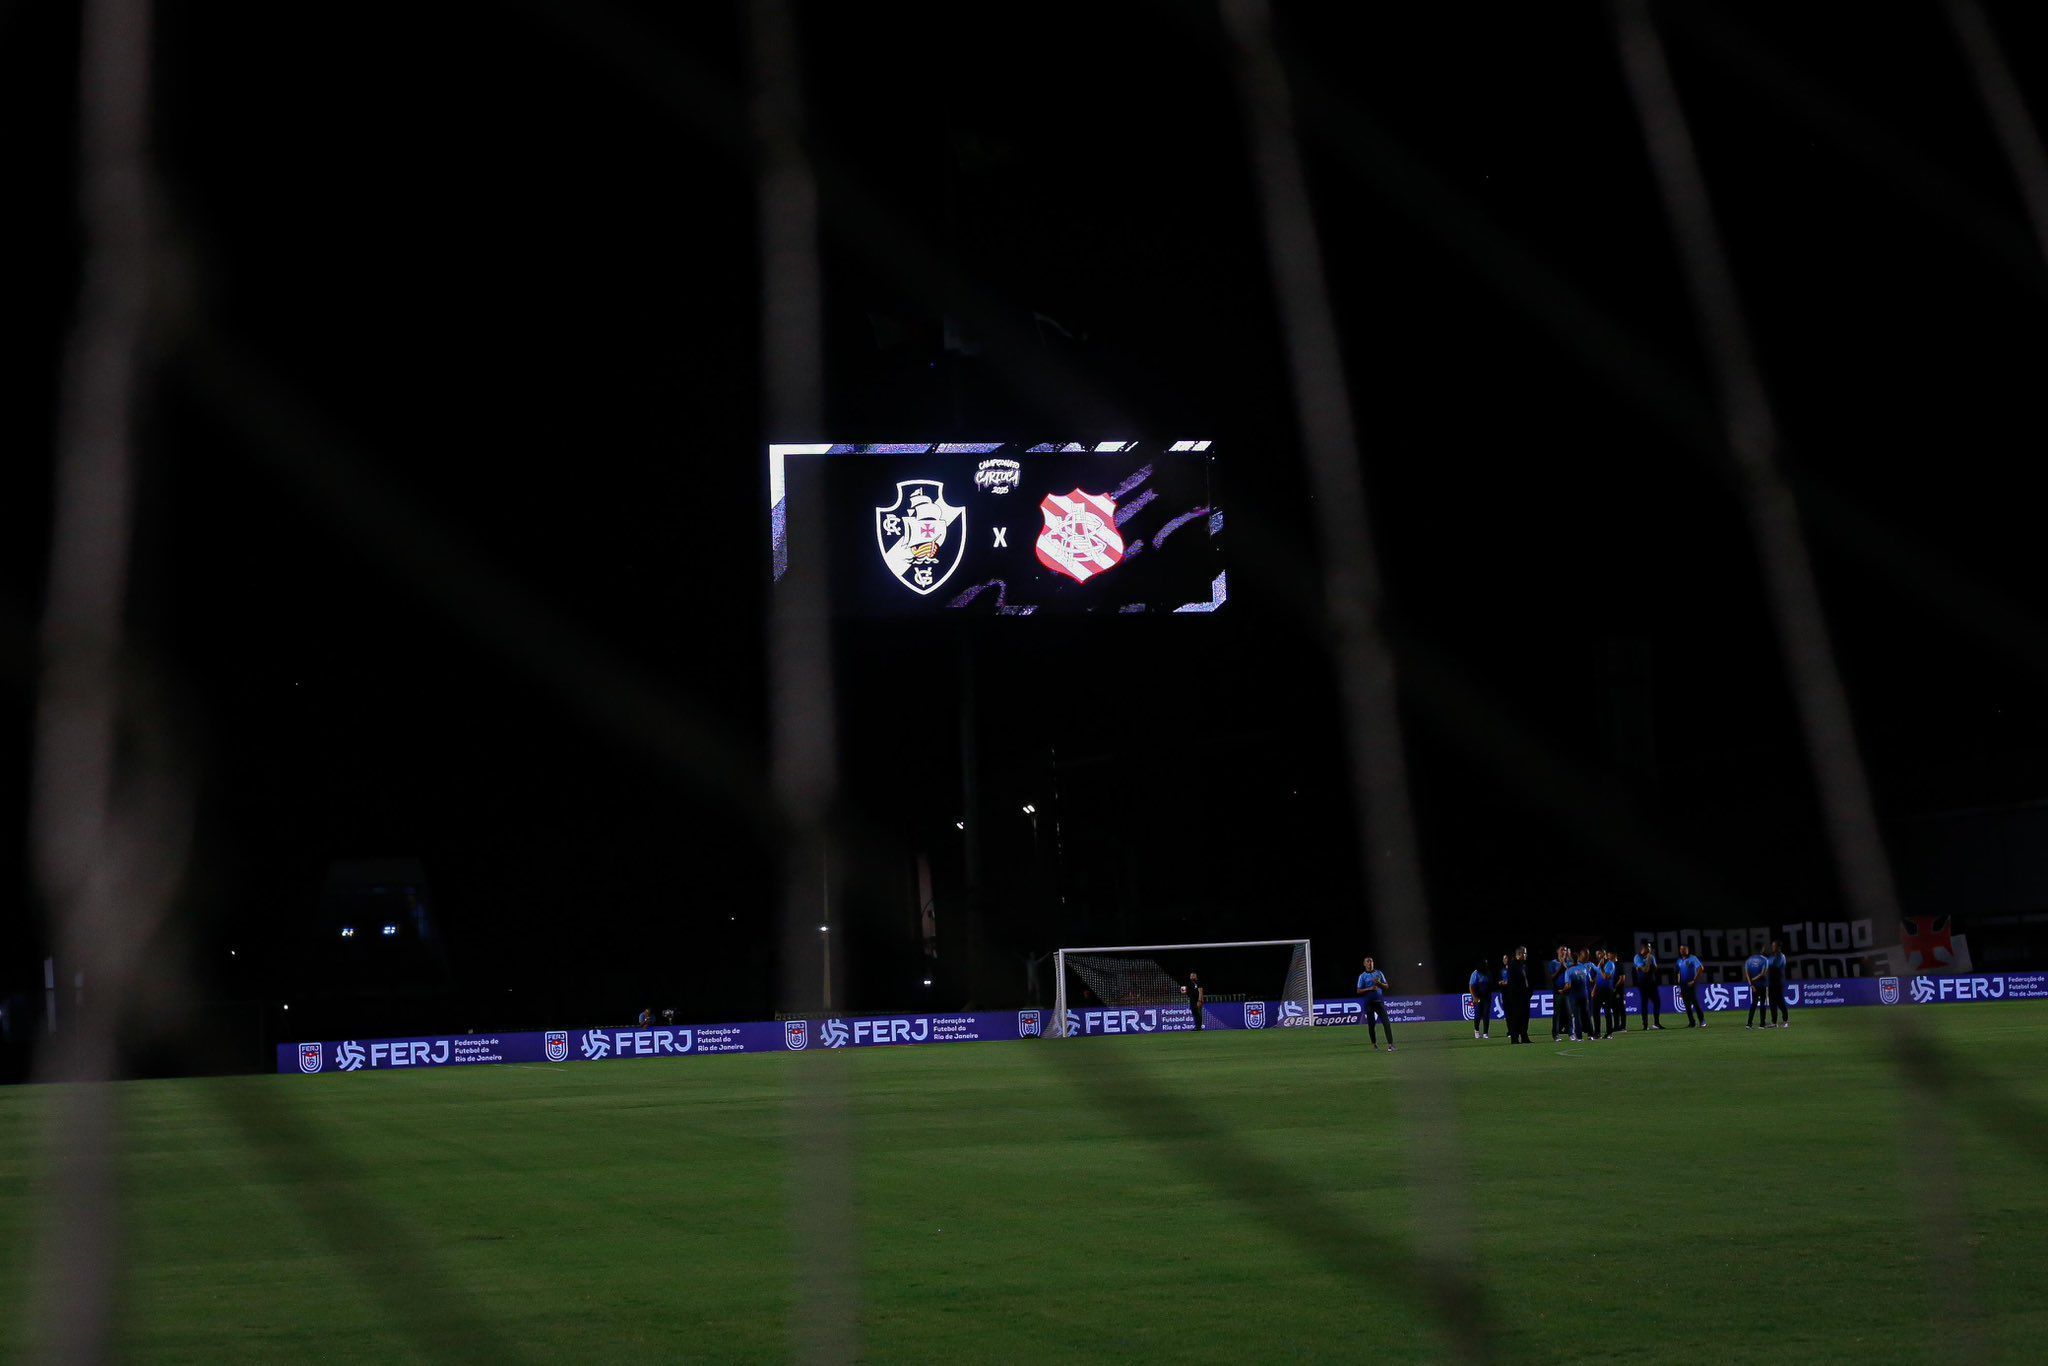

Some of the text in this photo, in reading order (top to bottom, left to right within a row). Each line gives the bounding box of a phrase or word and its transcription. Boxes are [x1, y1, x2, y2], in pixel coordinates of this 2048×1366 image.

[975, 470, 1020, 487] CARIOCA
[1782, 919, 1873, 953] TUDO
[1939, 977, 2004, 999] FERJ
[854, 1019, 928, 1043] FERJ
[1085, 1009, 1157, 1033] FERJ
[371, 1040, 449, 1066] FERJ
[616, 1030, 692, 1055] FERJ
